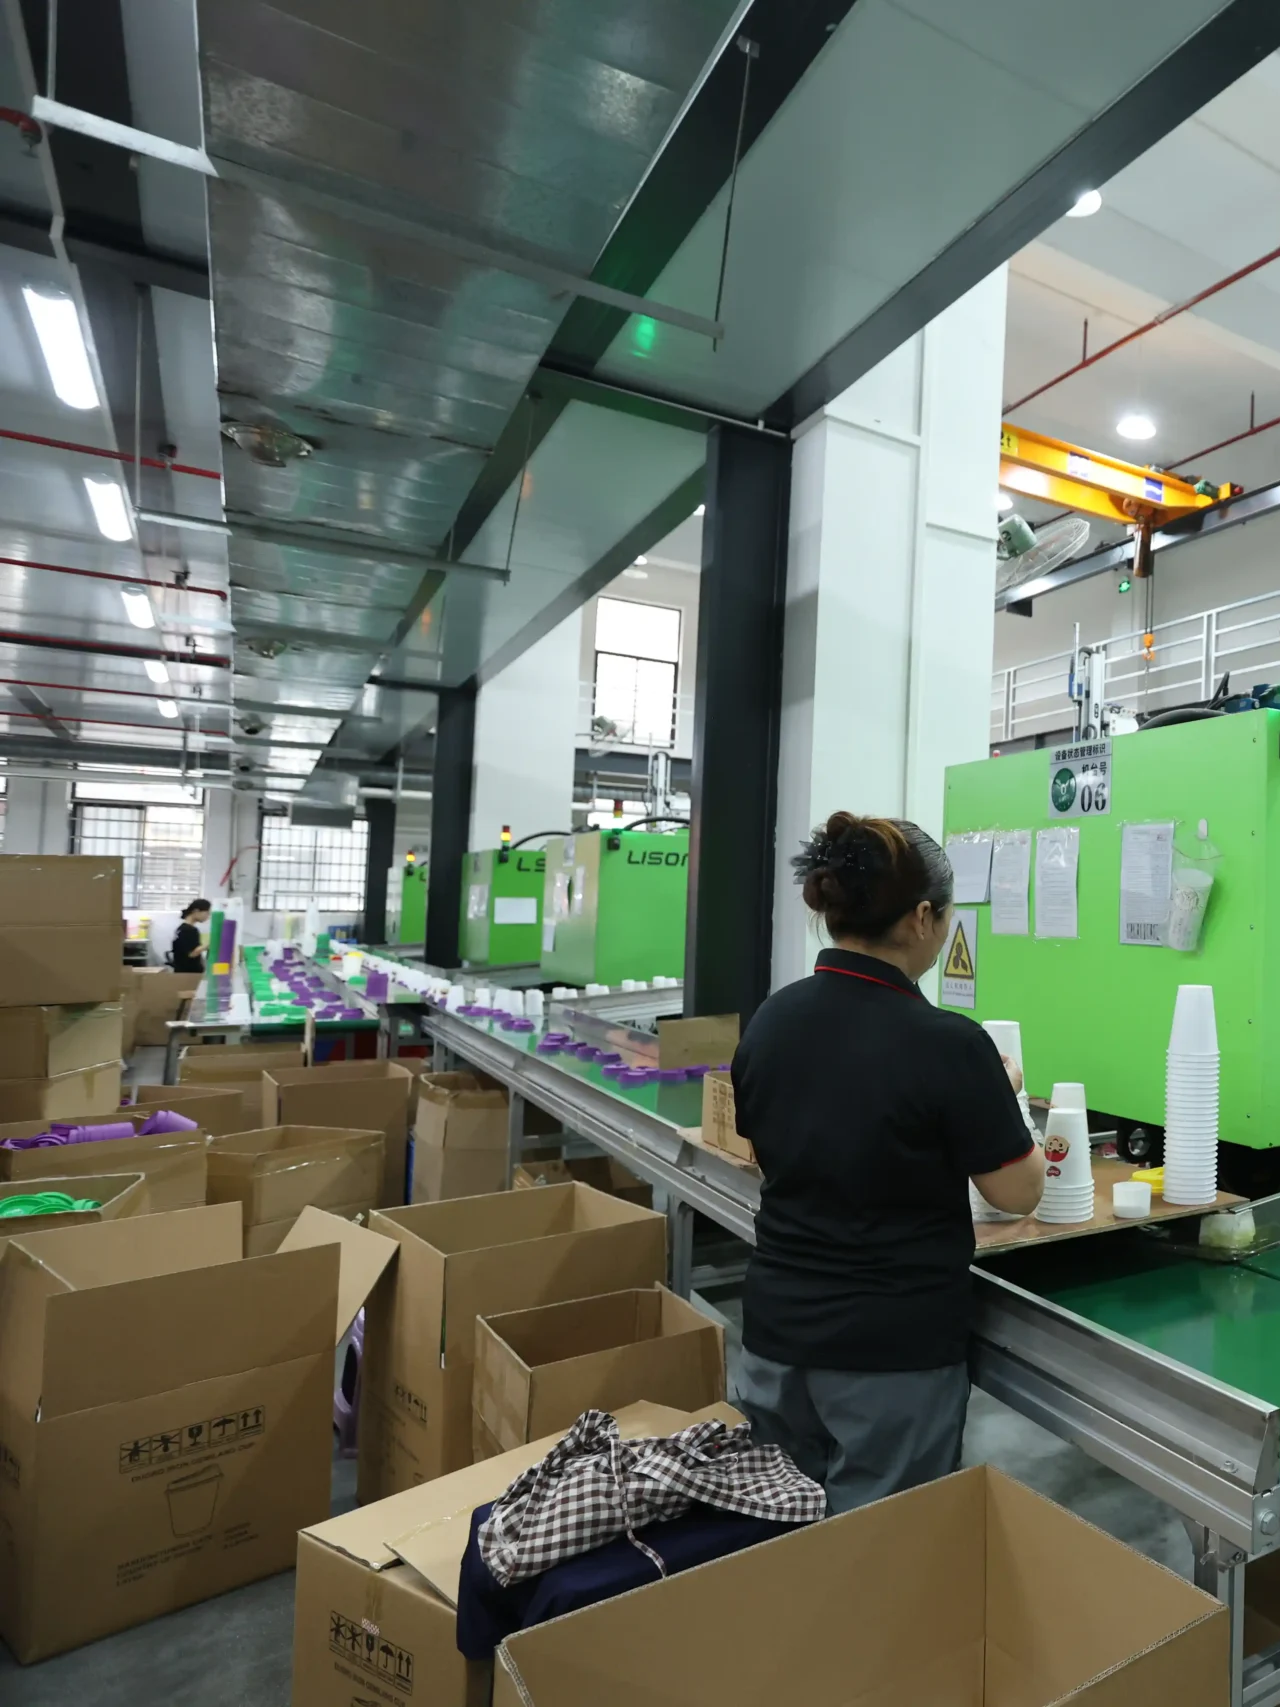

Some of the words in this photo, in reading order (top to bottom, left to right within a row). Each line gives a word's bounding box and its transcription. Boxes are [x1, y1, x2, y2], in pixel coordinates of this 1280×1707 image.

[1055, 744, 1106, 761] 设备状态管理标识
[1081, 762, 1107, 776] 机台号
[1081, 783, 1107, 812] 06
